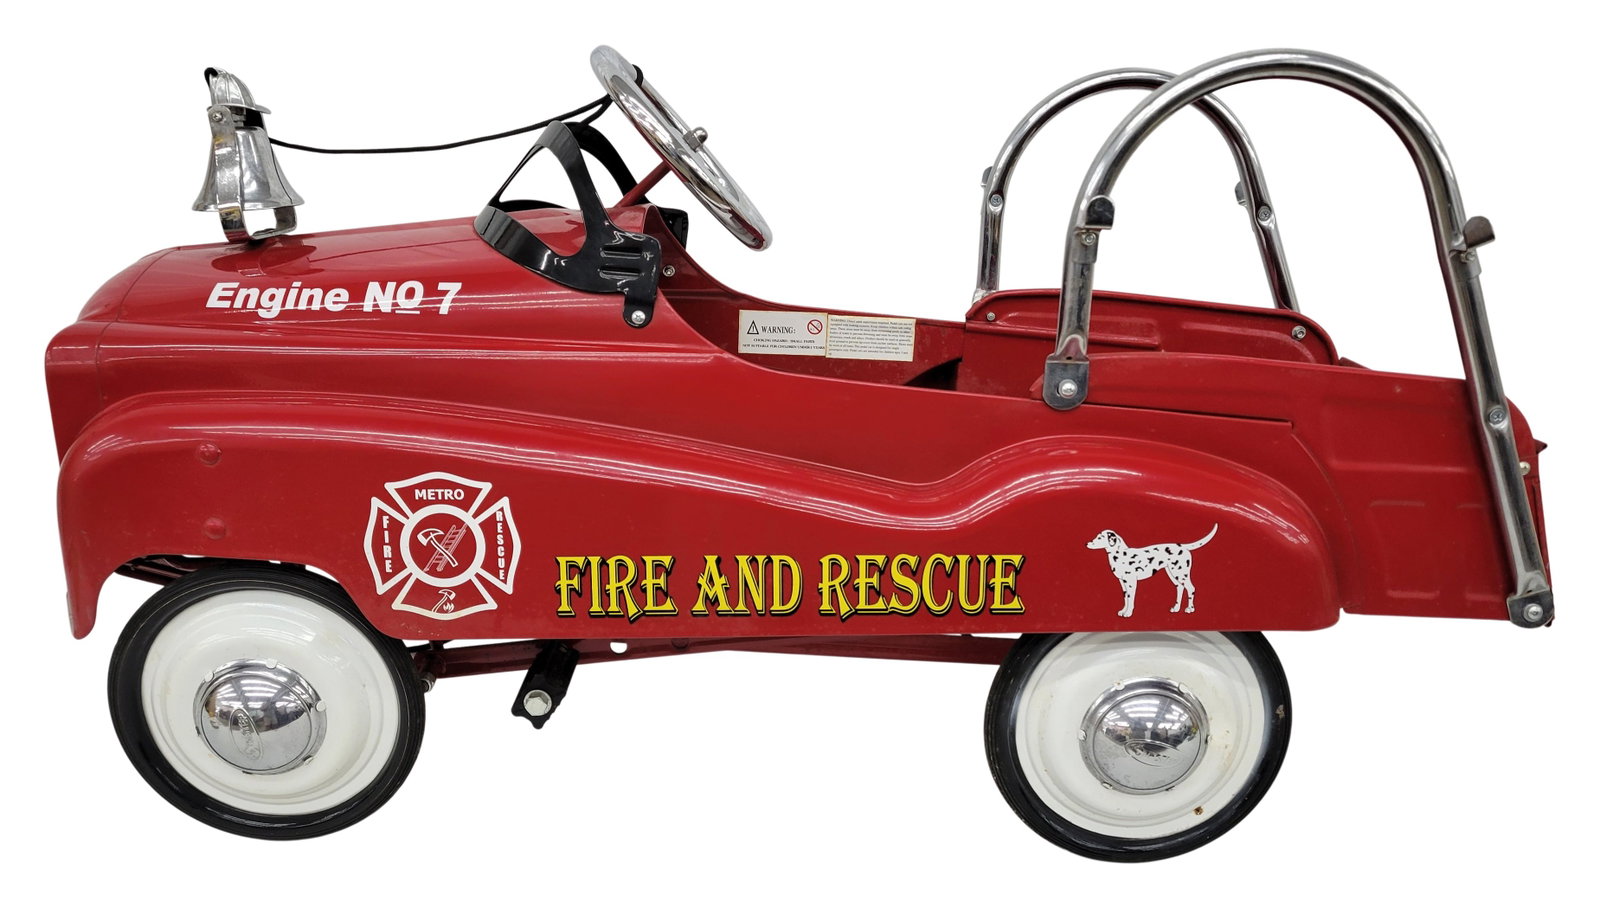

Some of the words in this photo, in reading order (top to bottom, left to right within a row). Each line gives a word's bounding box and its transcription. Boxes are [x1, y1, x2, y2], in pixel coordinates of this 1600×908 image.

[206, 281, 349, 318] Engine
[437, 282, 462, 315] 7
[761, 326, 796, 334] WARNING:
[414, 489, 464, 501] METRO
[382, 515, 392, 573] FIRE
[495, 511, 505, 580] RESCUE
[554, 555, 678, 622] FIRE
[690, 555, 803, 619] AND
[817, 554, 1026, 621] RESCUE
